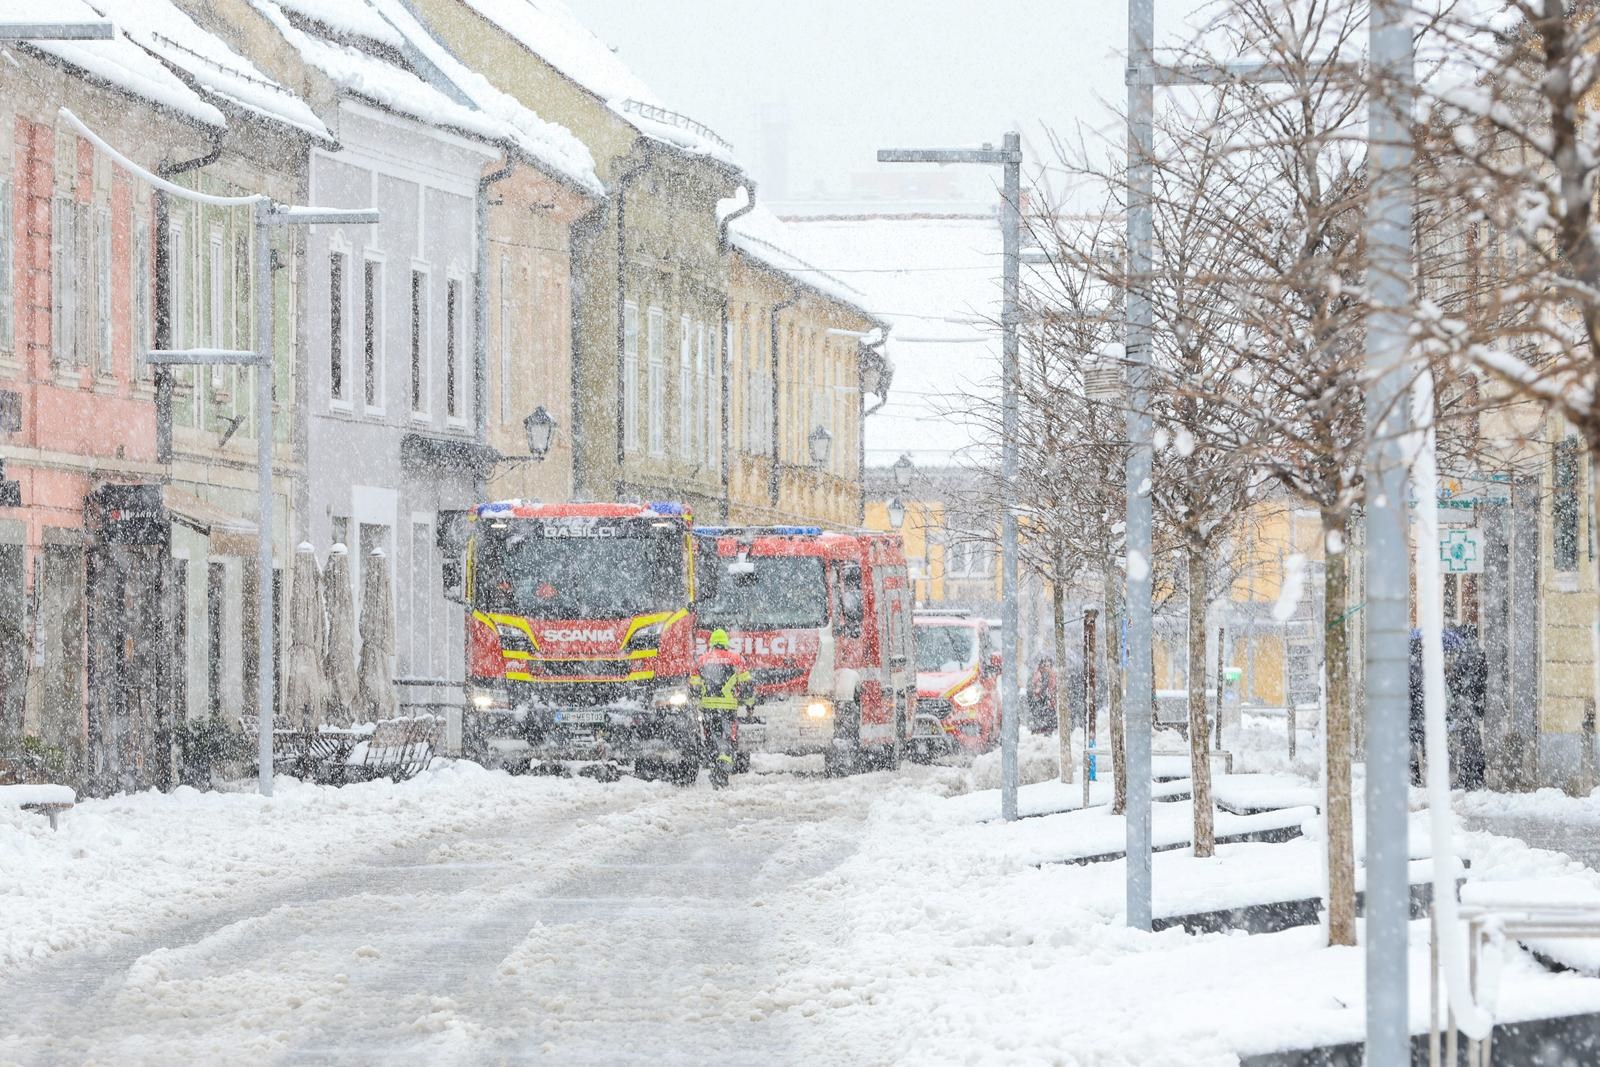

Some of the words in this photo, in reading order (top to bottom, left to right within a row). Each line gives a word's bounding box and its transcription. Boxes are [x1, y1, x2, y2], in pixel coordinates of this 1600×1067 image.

[544, 526, 615, 537] GASILCI
[544, 629, 616, 641] SCANIA
[694, 637, 796, 655] GSILCI
